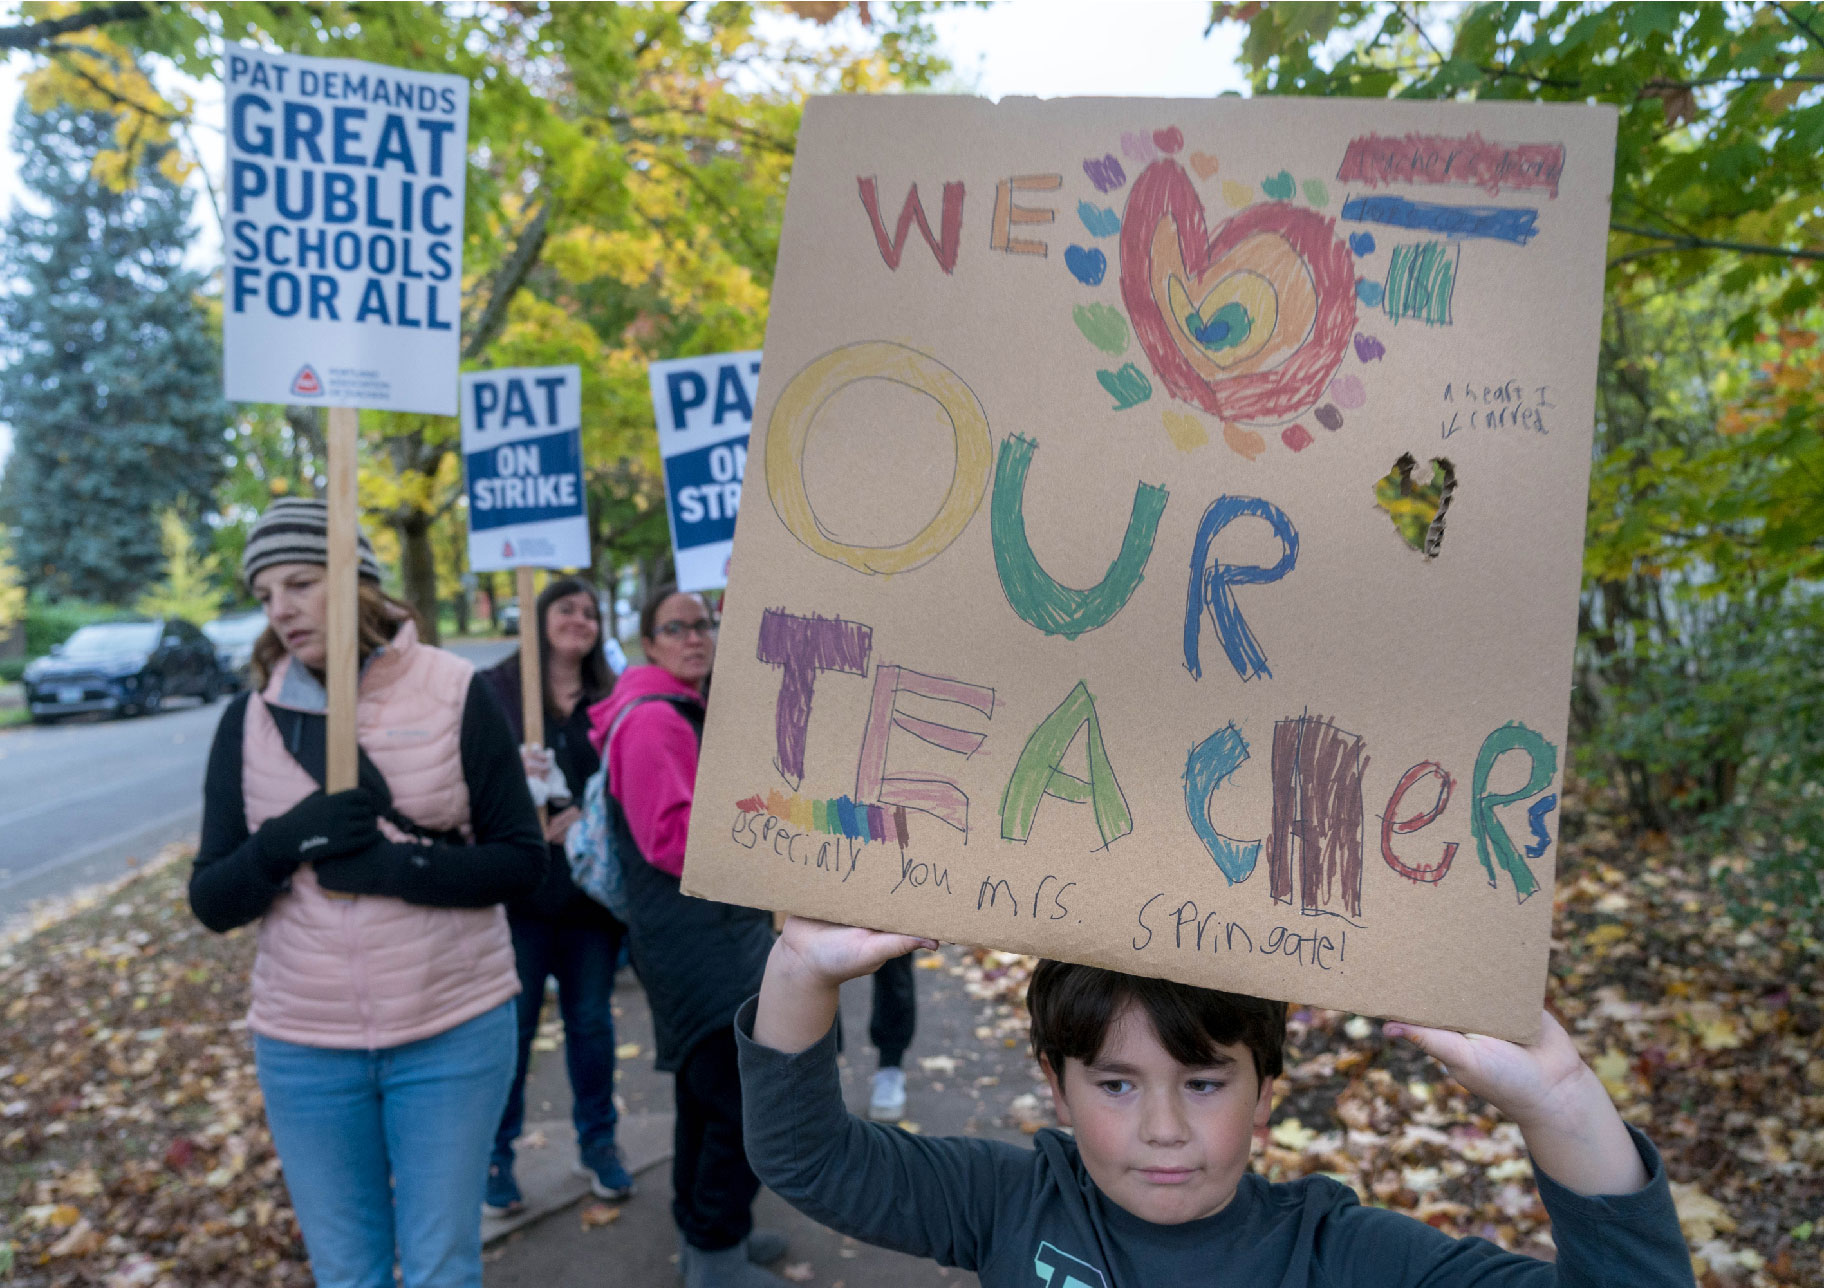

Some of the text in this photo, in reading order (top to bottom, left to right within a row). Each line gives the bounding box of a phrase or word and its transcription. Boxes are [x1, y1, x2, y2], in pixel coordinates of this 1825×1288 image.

[230, 55, 457, 115] PAT DEMANDS
[231, 92, 456, 178] GREAT
[232, 158, 454, 236] PUBLIC
[857, 173, 1063, 275] WE
[233, 219, 453, 282] SCHOOLS
[233, 266, 452, 331] FOR ALL
[472, 376, 565, 432] PAT
[665, 362, 761, 433] PA
[473, 473, 577, 511] STRIKE
[496, 443, 540, 477] ON
[764, 339, 1300, 683] OUR
[889, 847, 953, 895] you
